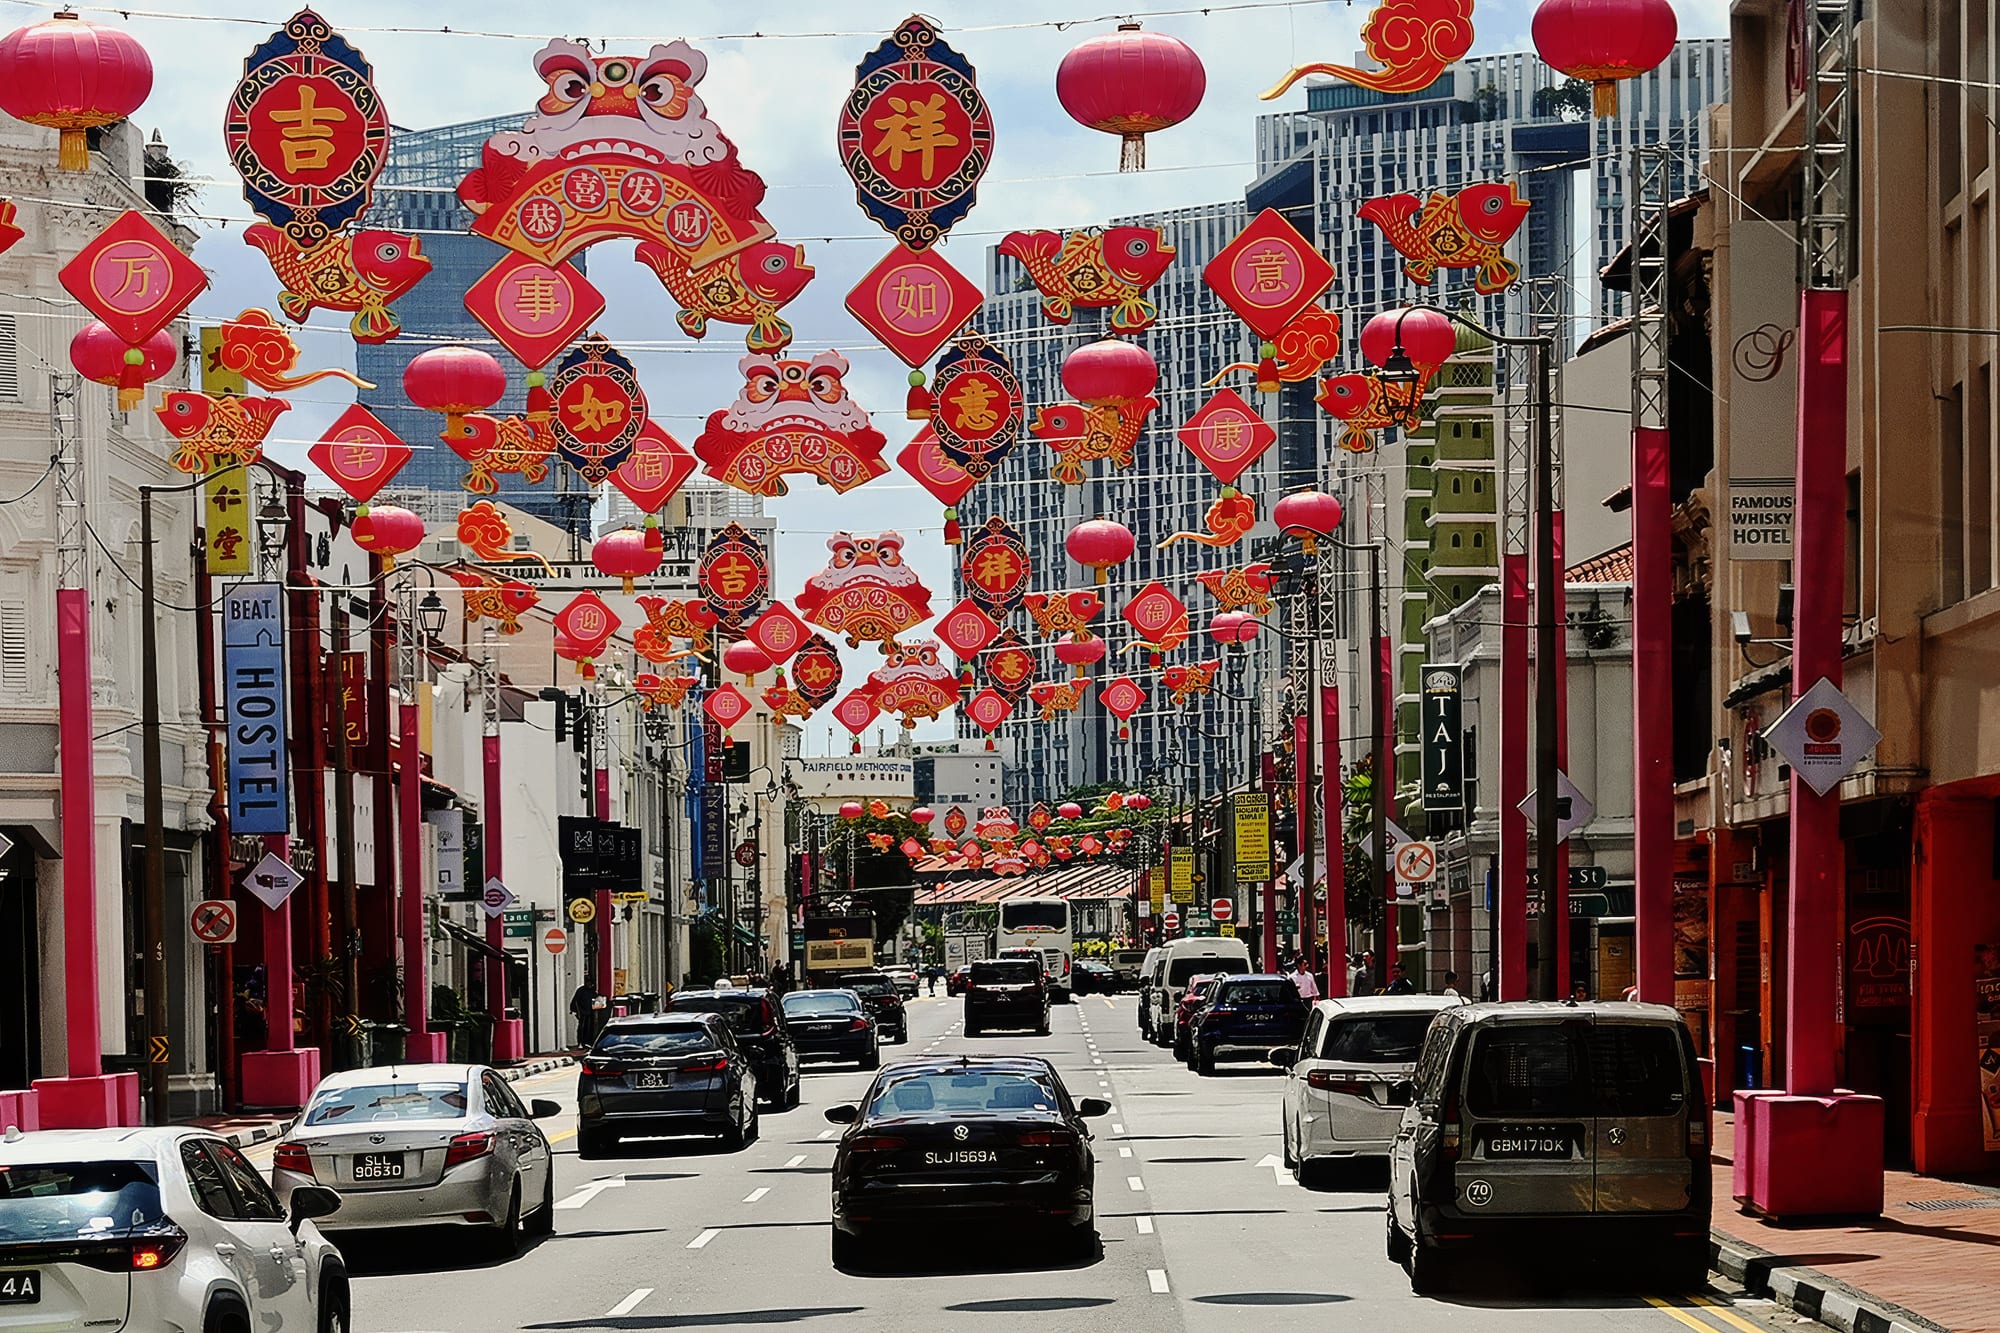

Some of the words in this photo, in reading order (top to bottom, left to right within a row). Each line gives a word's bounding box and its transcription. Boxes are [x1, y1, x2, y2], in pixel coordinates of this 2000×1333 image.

[269, 84, 347, 174] 吉
[873, 93, 959, 180] 祥
[524, 172, 705, 237] 恭喜发财
[1434, 230, 1459, 251] 福
[110, 253, 159, 298] 万
[317, 264, 341, 291] 福
[1072, 267, 1096, 290] 福
[1247, 249, 1290, 293] 意
[514, 275, 562, 322] 事
[707, 279, 732, 304] 福
[891, 276, 936, 321] 如
[568, 383, 624, 432] 如
[949, 378, 999, 431] 意
[1211, 417, 1243, 451] 康
[343, 435, 376, 468] 幸
[632, 447, 663, 481] 福
[741, 438, 855, 478] 恭喜发财
[1731, 496, 1793, 509] FAMOUS
[1731, 513, 1793, 525] WHISKY
[1733, 528, 1791, 544] HOTEL
[716, 556, 751, 596] 吉
[977, 550, 1016, 590] 祥
[231, 599, 276, 620] BEAT.
[577, 611, 599, 633] 迎
[1144, 599, 1166, 624] 福
[768, 621, 790, 645] 春
[956, 619, 979, 642] 纳
[803, 658, 832, 684] 如
[236, 667, 278, 818] HOSTEL
[1432, 695, 1452, 776] TAJ
[803, 762, 853, 772] FAIRFIELD
[1580, 869, 1598, 884] St
[925, 1150, 998, 1164] SLJ1569A
[1491, 1139, 1565, 1152] GBM1710K
[365, 1155, 392, 1166] SLL
[1471, 1184, 1489, 1196] 70
